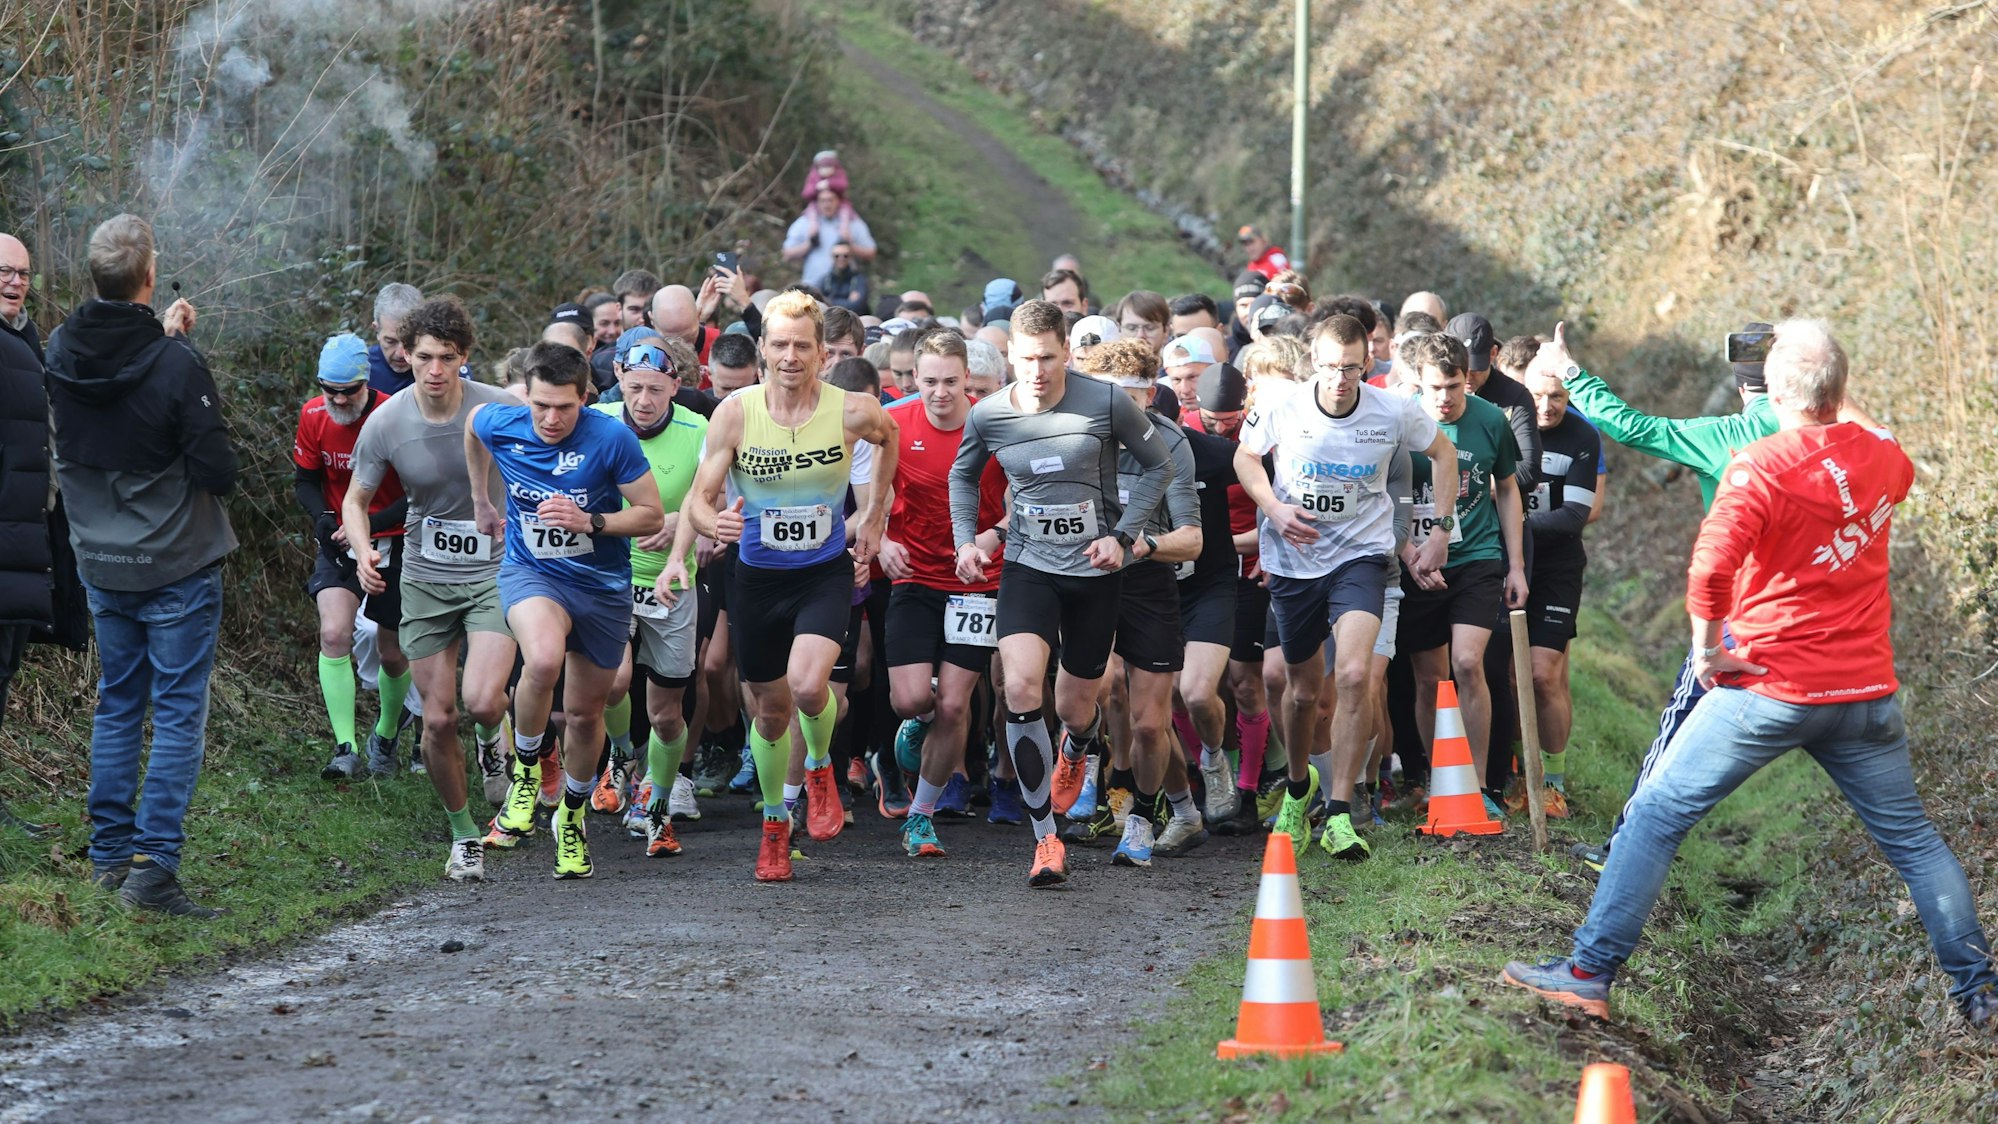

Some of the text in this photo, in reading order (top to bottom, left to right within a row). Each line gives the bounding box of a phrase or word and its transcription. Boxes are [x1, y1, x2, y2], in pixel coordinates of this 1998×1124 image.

[749, 446, 787, 456] mission
[795, 445, 844, 469] SRS
[1456, 449, 1474, 461] INER
[754, 473, 783, 483] sport
[1821, 457, 1859, 518] Kempa
[508, 482, 588, 508] Xcoong
[1302, 493, 1344, 513] 505
[1458, 490, 1483, 520] ARATHON
[532, 527, 580, 548] 762
[773, 520, 817, 542] 691
[1038, 517, 1084, 536] 765
[434, 530, 478, 555] 690
[956, 611, 997, 635] 787
